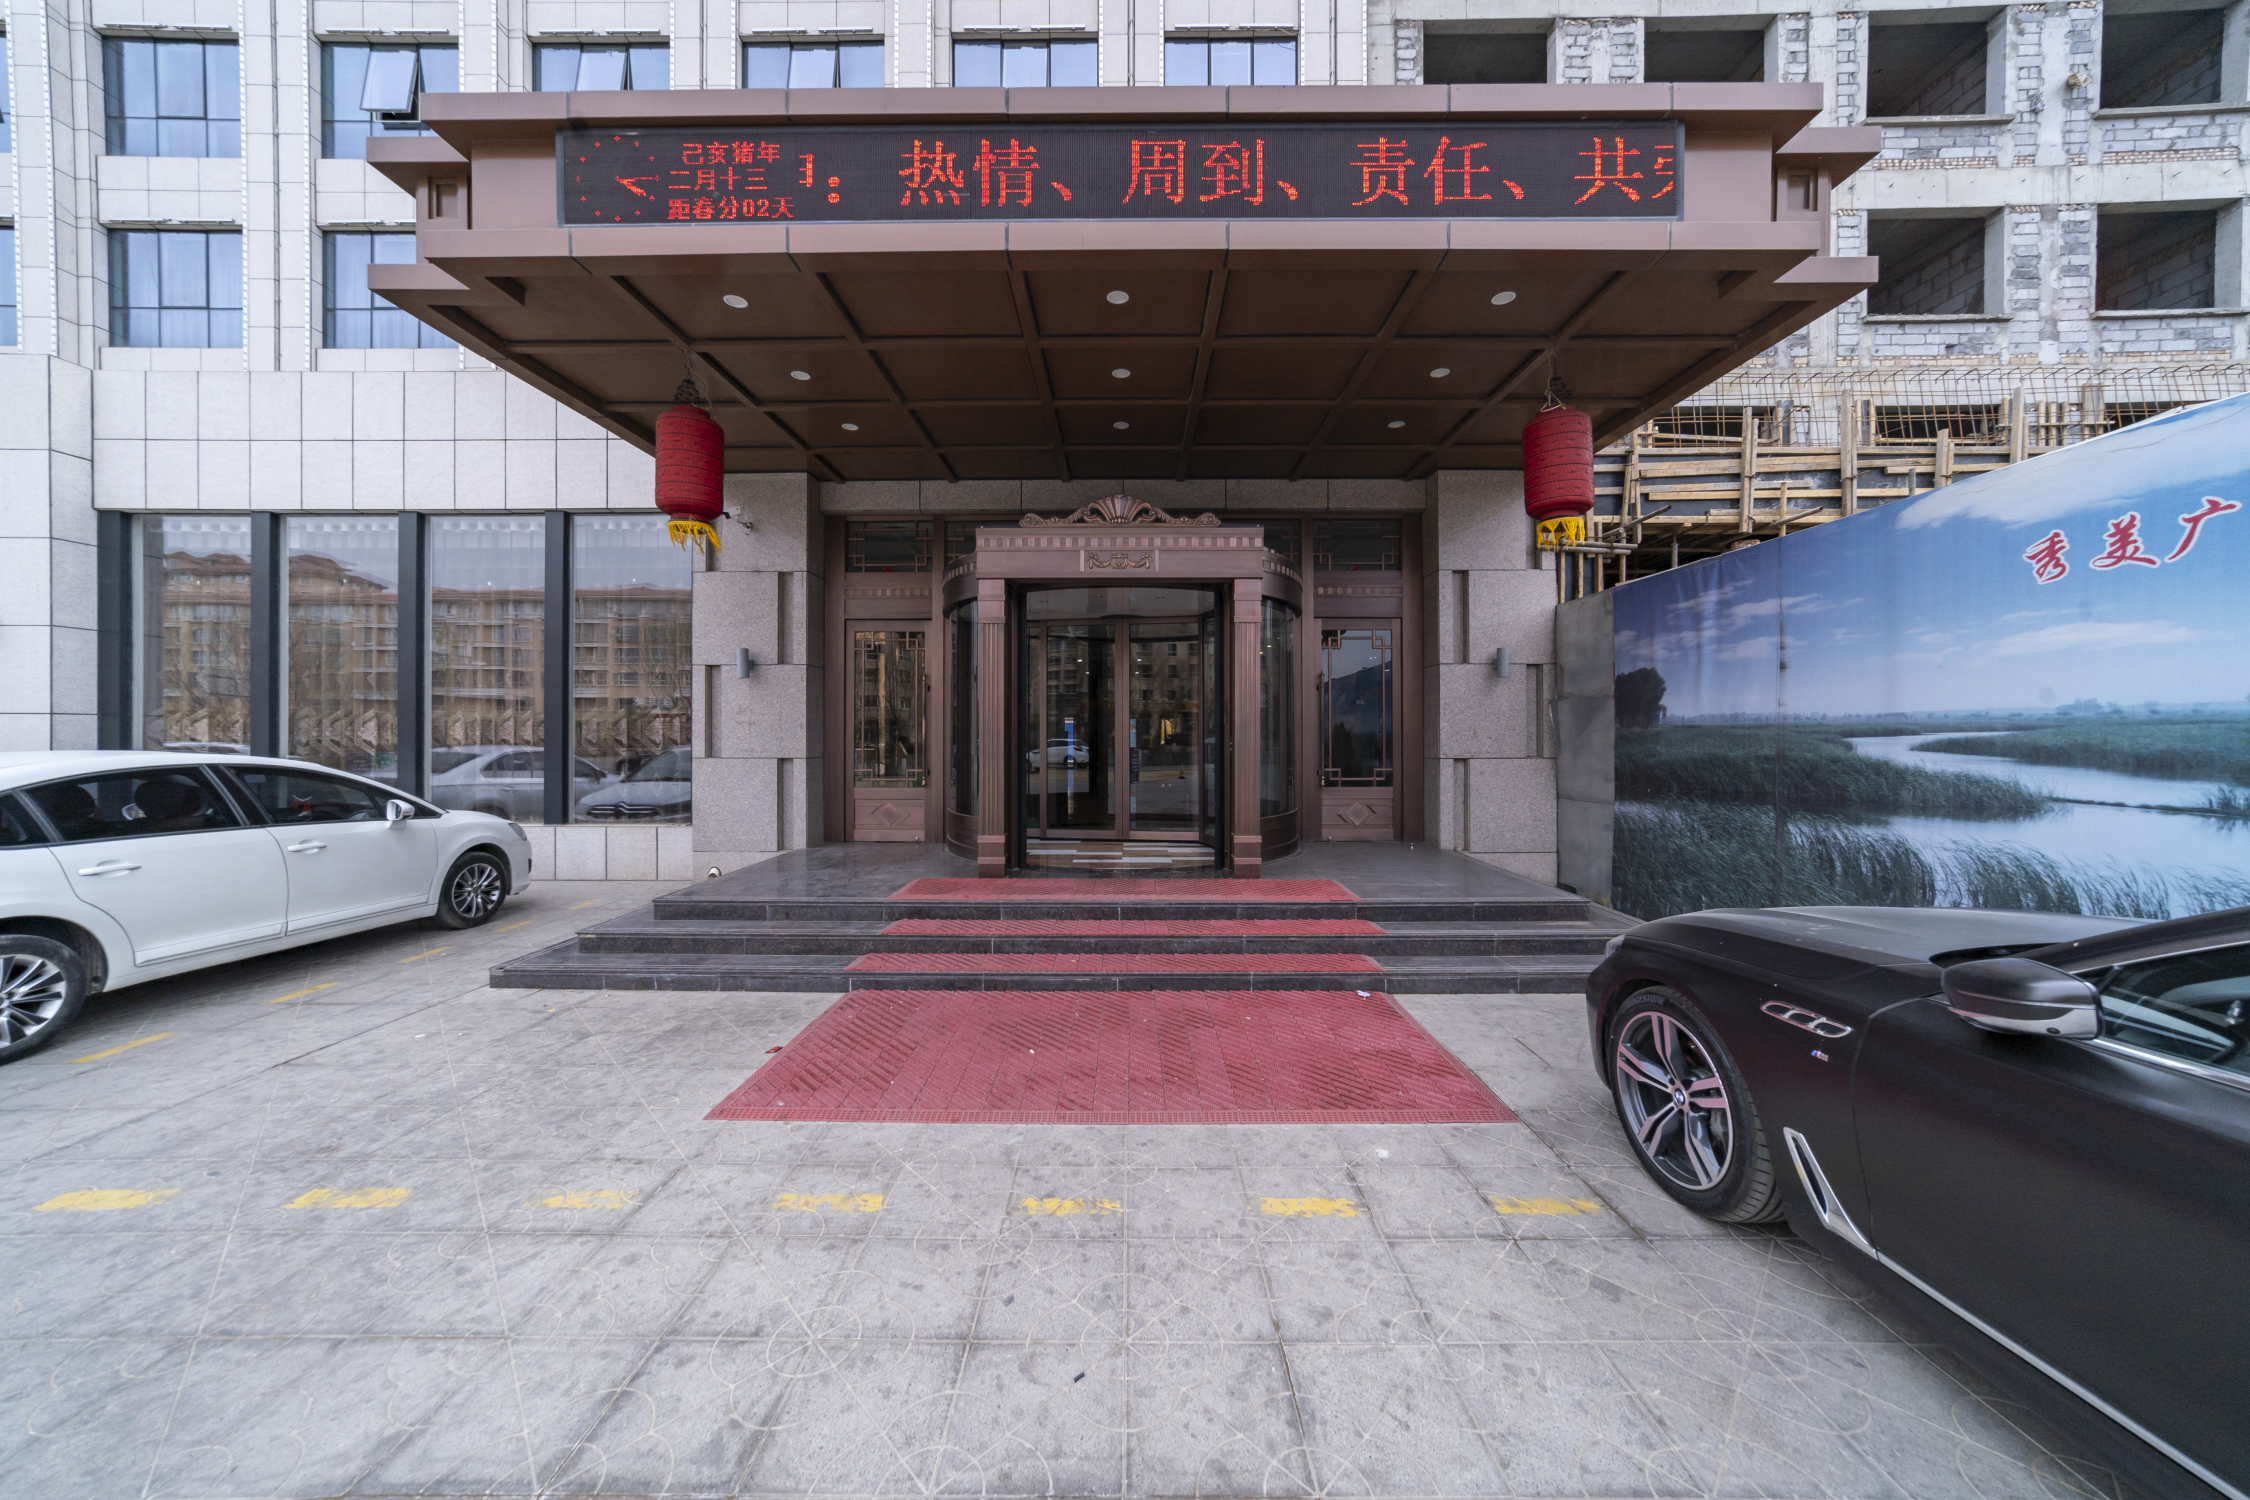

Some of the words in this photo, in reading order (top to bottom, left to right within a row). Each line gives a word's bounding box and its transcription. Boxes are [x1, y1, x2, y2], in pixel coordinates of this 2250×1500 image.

[683, 141, 780, 164] 己亥猪年
[668, 167, 768, 190] 二月十三
[667, 196, 794, 219] 距春分02天
